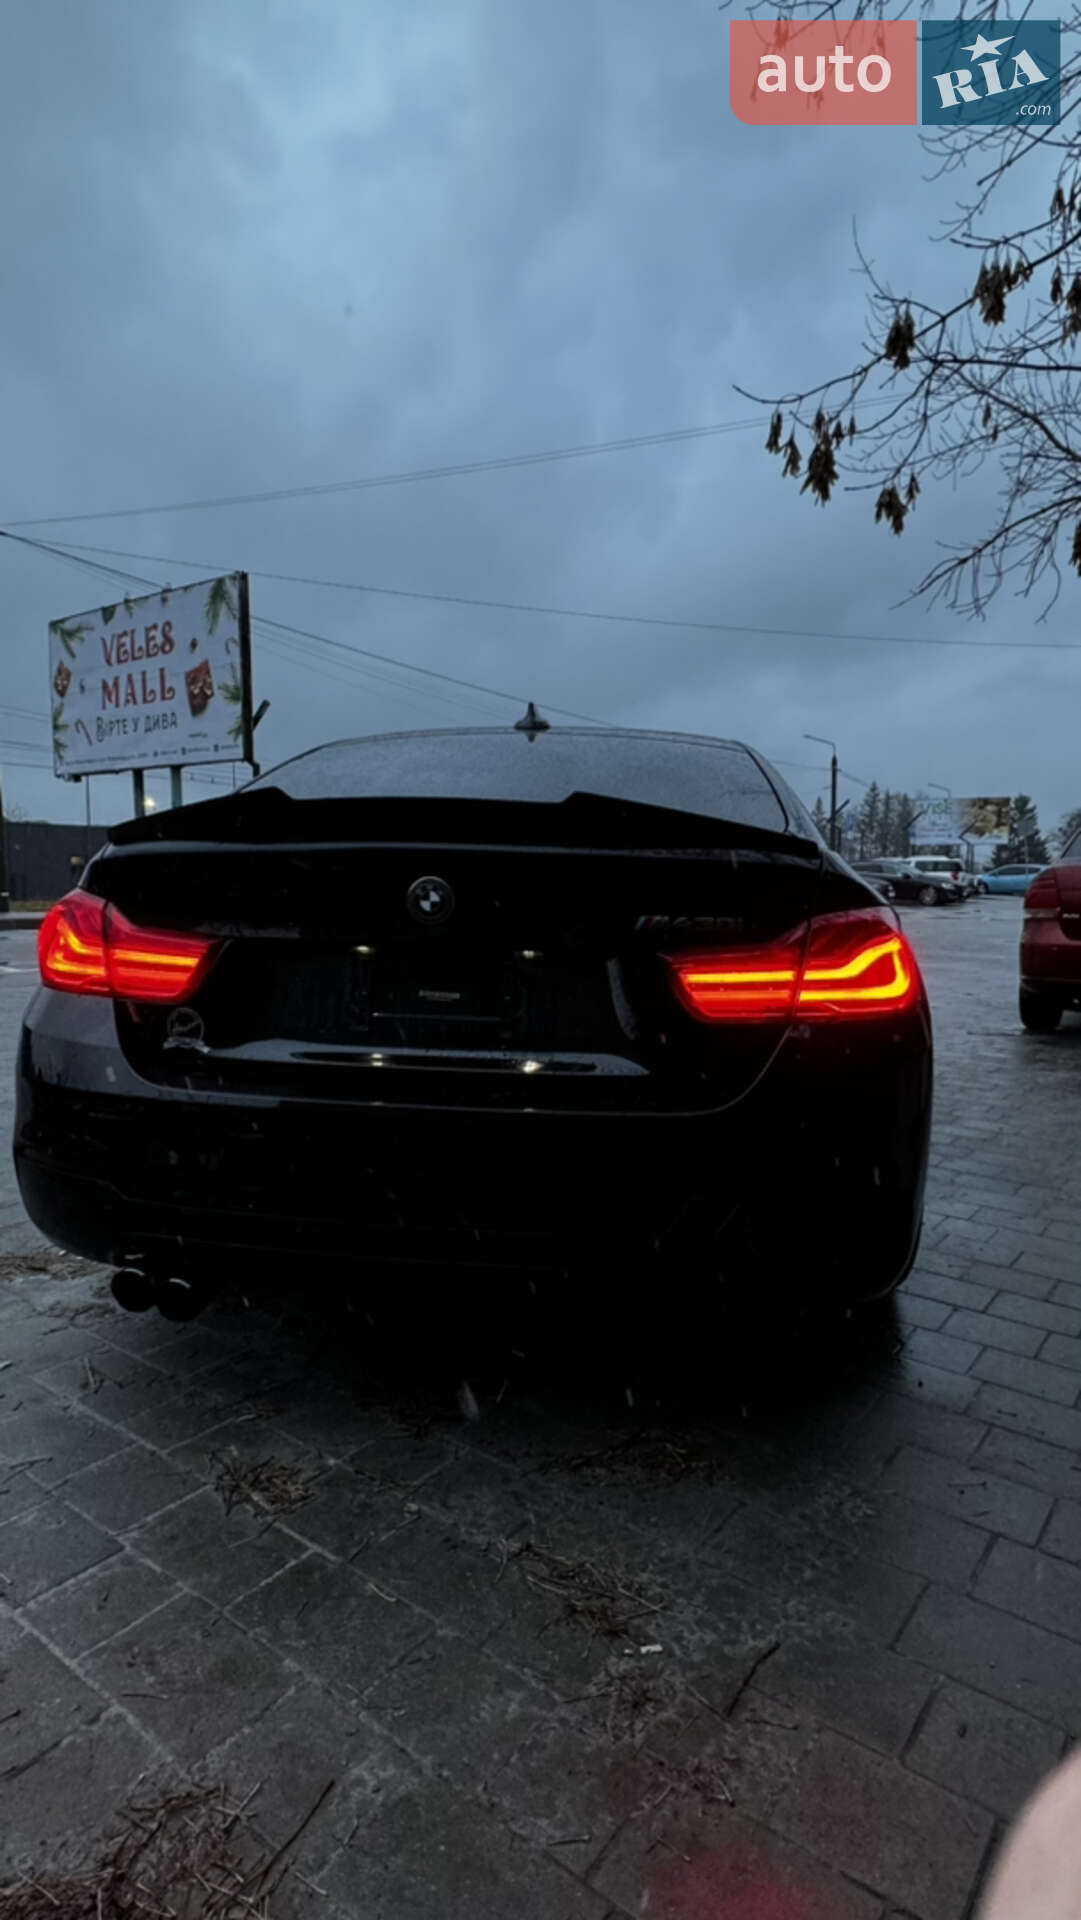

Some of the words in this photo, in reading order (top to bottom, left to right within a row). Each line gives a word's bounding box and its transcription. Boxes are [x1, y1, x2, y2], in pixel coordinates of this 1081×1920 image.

[101, 621, 175, 667] VELES
[101, 667, 176, 710] MALL
[144, 712, 179, 734] ДИВА
